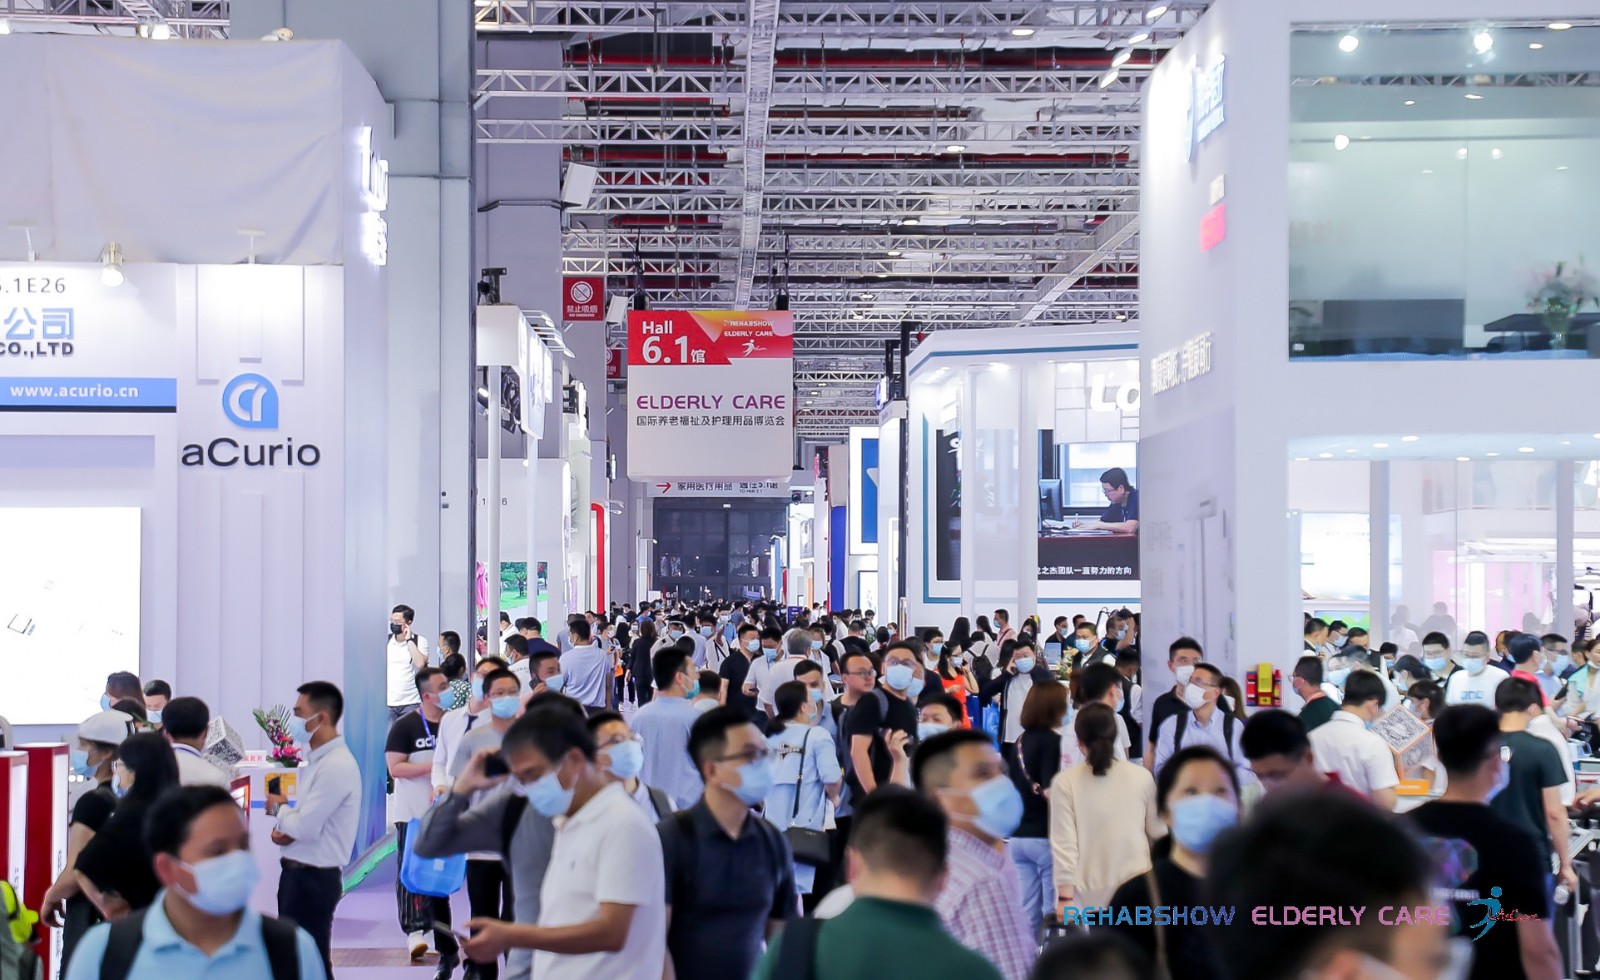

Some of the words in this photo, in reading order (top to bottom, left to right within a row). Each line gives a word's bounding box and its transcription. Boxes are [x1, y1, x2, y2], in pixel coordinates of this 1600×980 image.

[0, 277, 66, 293] .1E26
[4, 306, 75, 340] 公司
[642, 320, 673, 335] Hall
[10, 384, 139, 398] www.acurio.cn
[636, 395, 723, 410] ELDERLY
[732, 395, 786, 410] CARE
[636, 415, 786, 427] 国际养老福祉及护理用品博览会
[181, 437, 321, 467] aCurio
